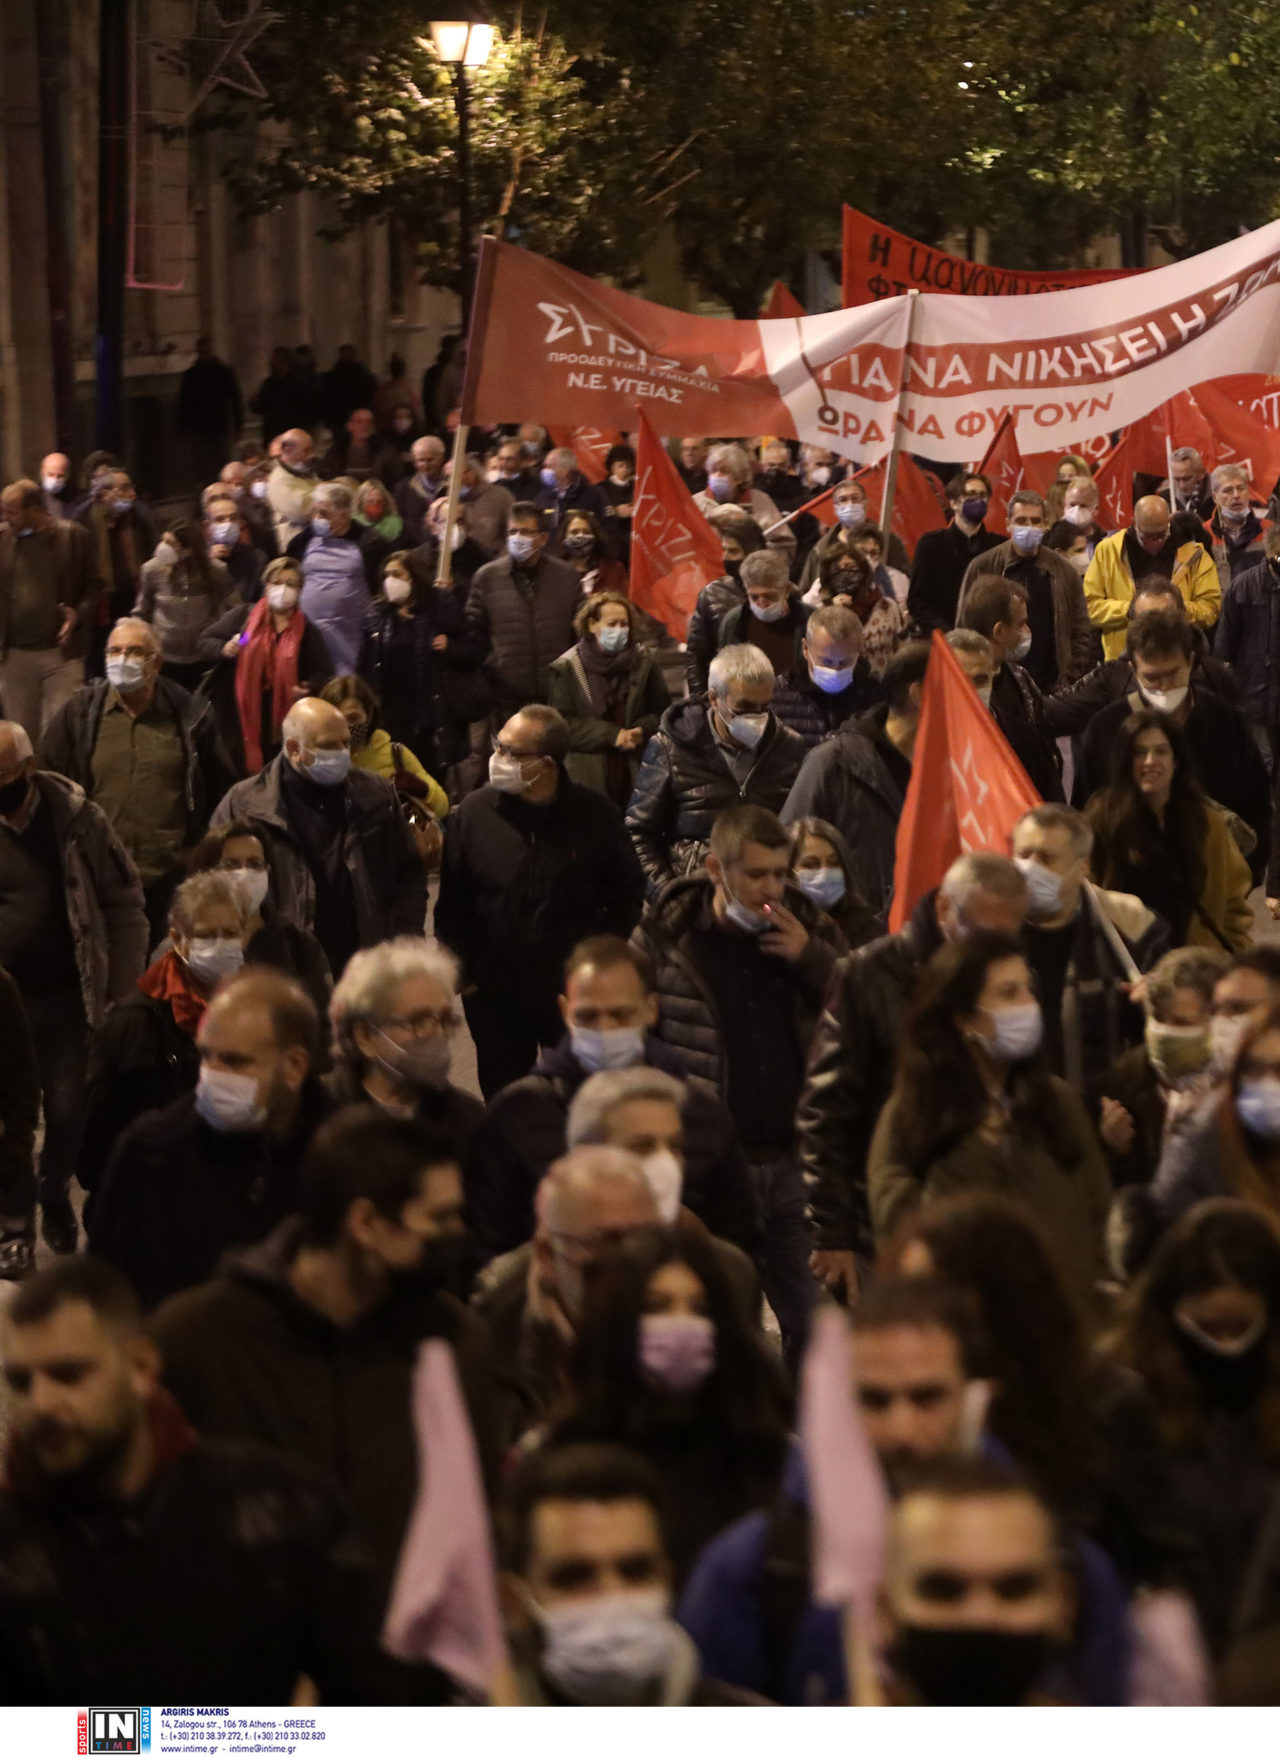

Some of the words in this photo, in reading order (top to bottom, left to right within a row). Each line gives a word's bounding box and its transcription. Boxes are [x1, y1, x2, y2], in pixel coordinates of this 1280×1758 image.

[822, 353, 894, 393] ΓΙΑ
[906, 353, 973, 389] ΝΑ
[986, 321, 1168, 382] ΝΙΚΗΣΕΙ
[1170, 303, 1207, 341] Η
[567, 371, 608, 390] Ν.Ε.
[611, 376, 684, 404] ΥΓΕΙΑΣ
[892, 409, 946, 440] ΝΑ
[954, 391, 1115, 438] ΦΥΓΟΥΝ
